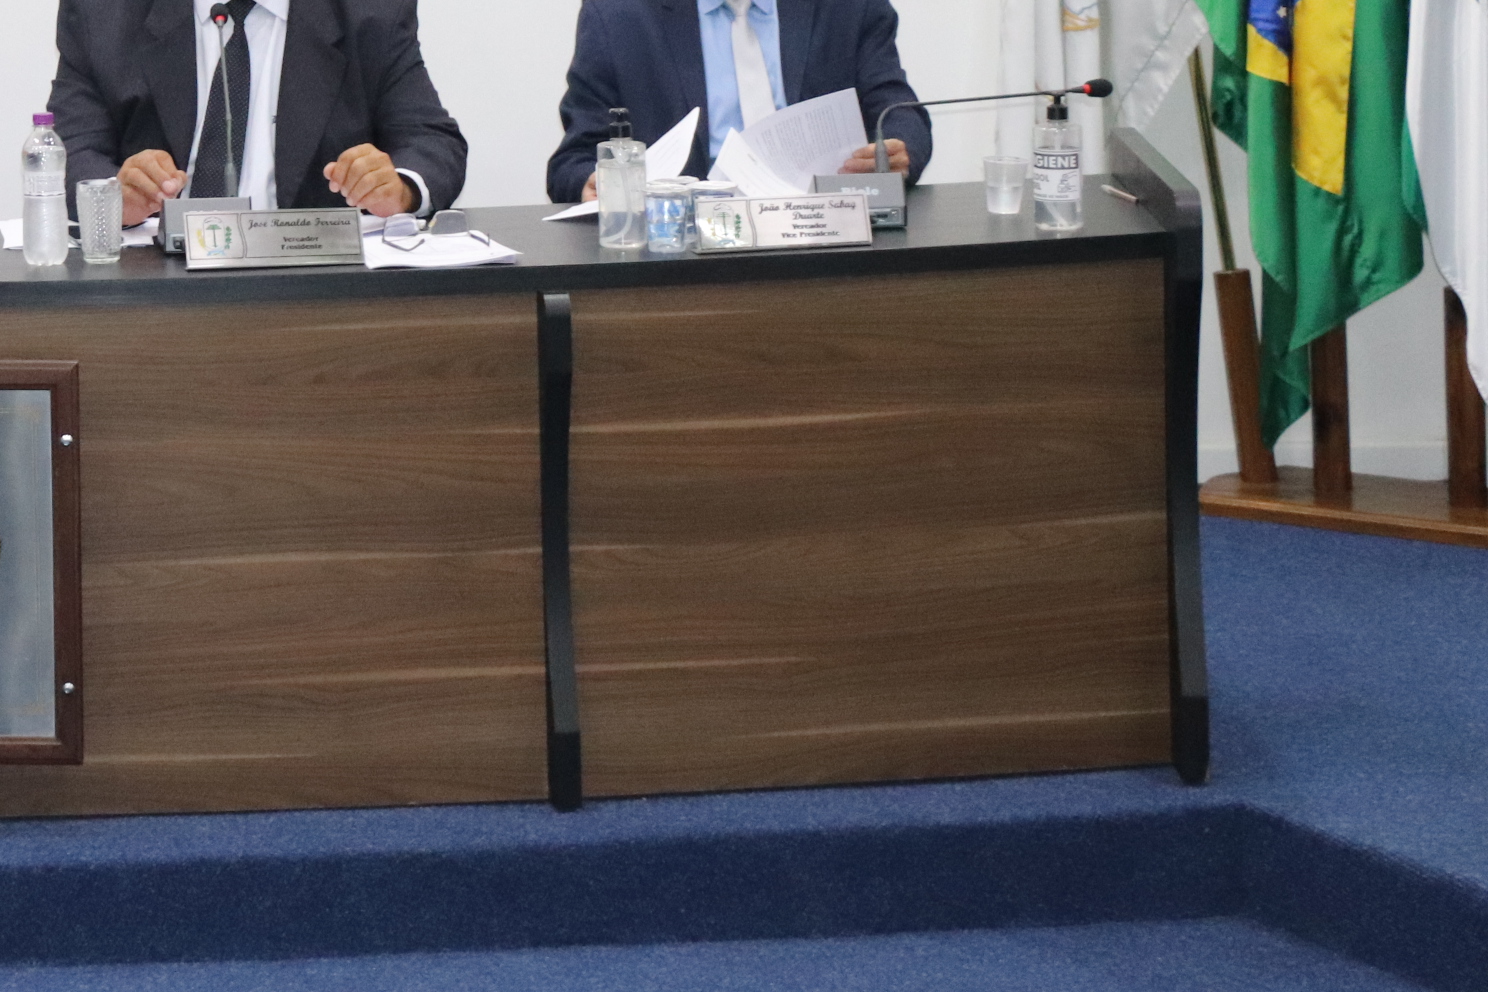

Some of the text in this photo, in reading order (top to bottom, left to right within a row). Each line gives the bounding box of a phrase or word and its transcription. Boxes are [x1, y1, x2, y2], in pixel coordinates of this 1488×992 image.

[783, 202, 825, 211] Henrique
[792, 211, 825, 220] Duarte
[799, 230, 840, 238] Presidente
